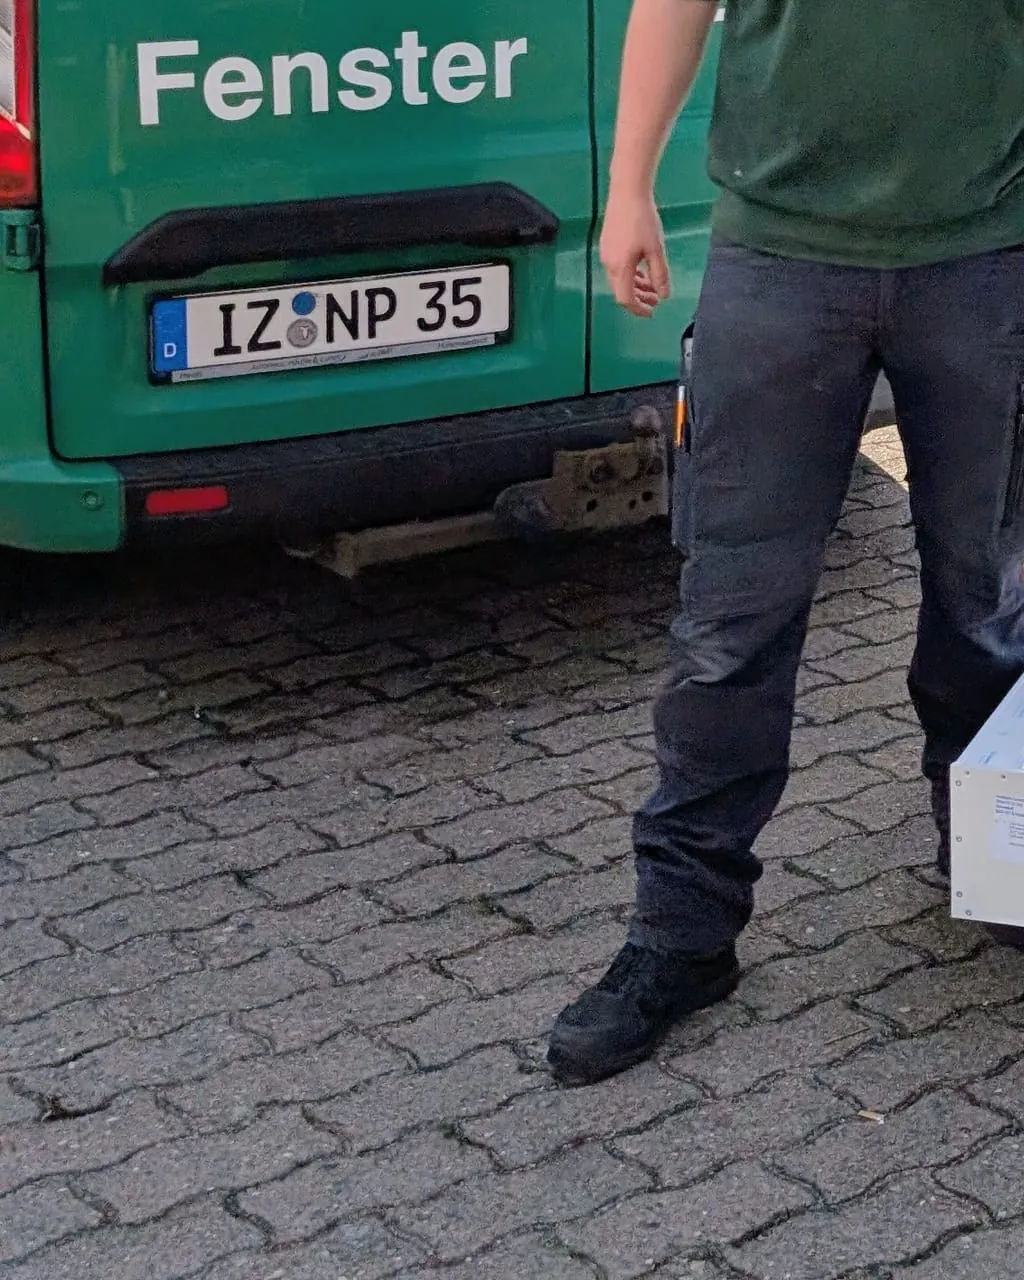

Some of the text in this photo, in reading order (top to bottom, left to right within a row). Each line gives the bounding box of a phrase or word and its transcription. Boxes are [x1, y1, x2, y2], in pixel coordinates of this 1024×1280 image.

[137, 30, 528, 126] Fenster
[163, 342, 177, 359] D
[214, 277, 483, 357] IZ NP 35
